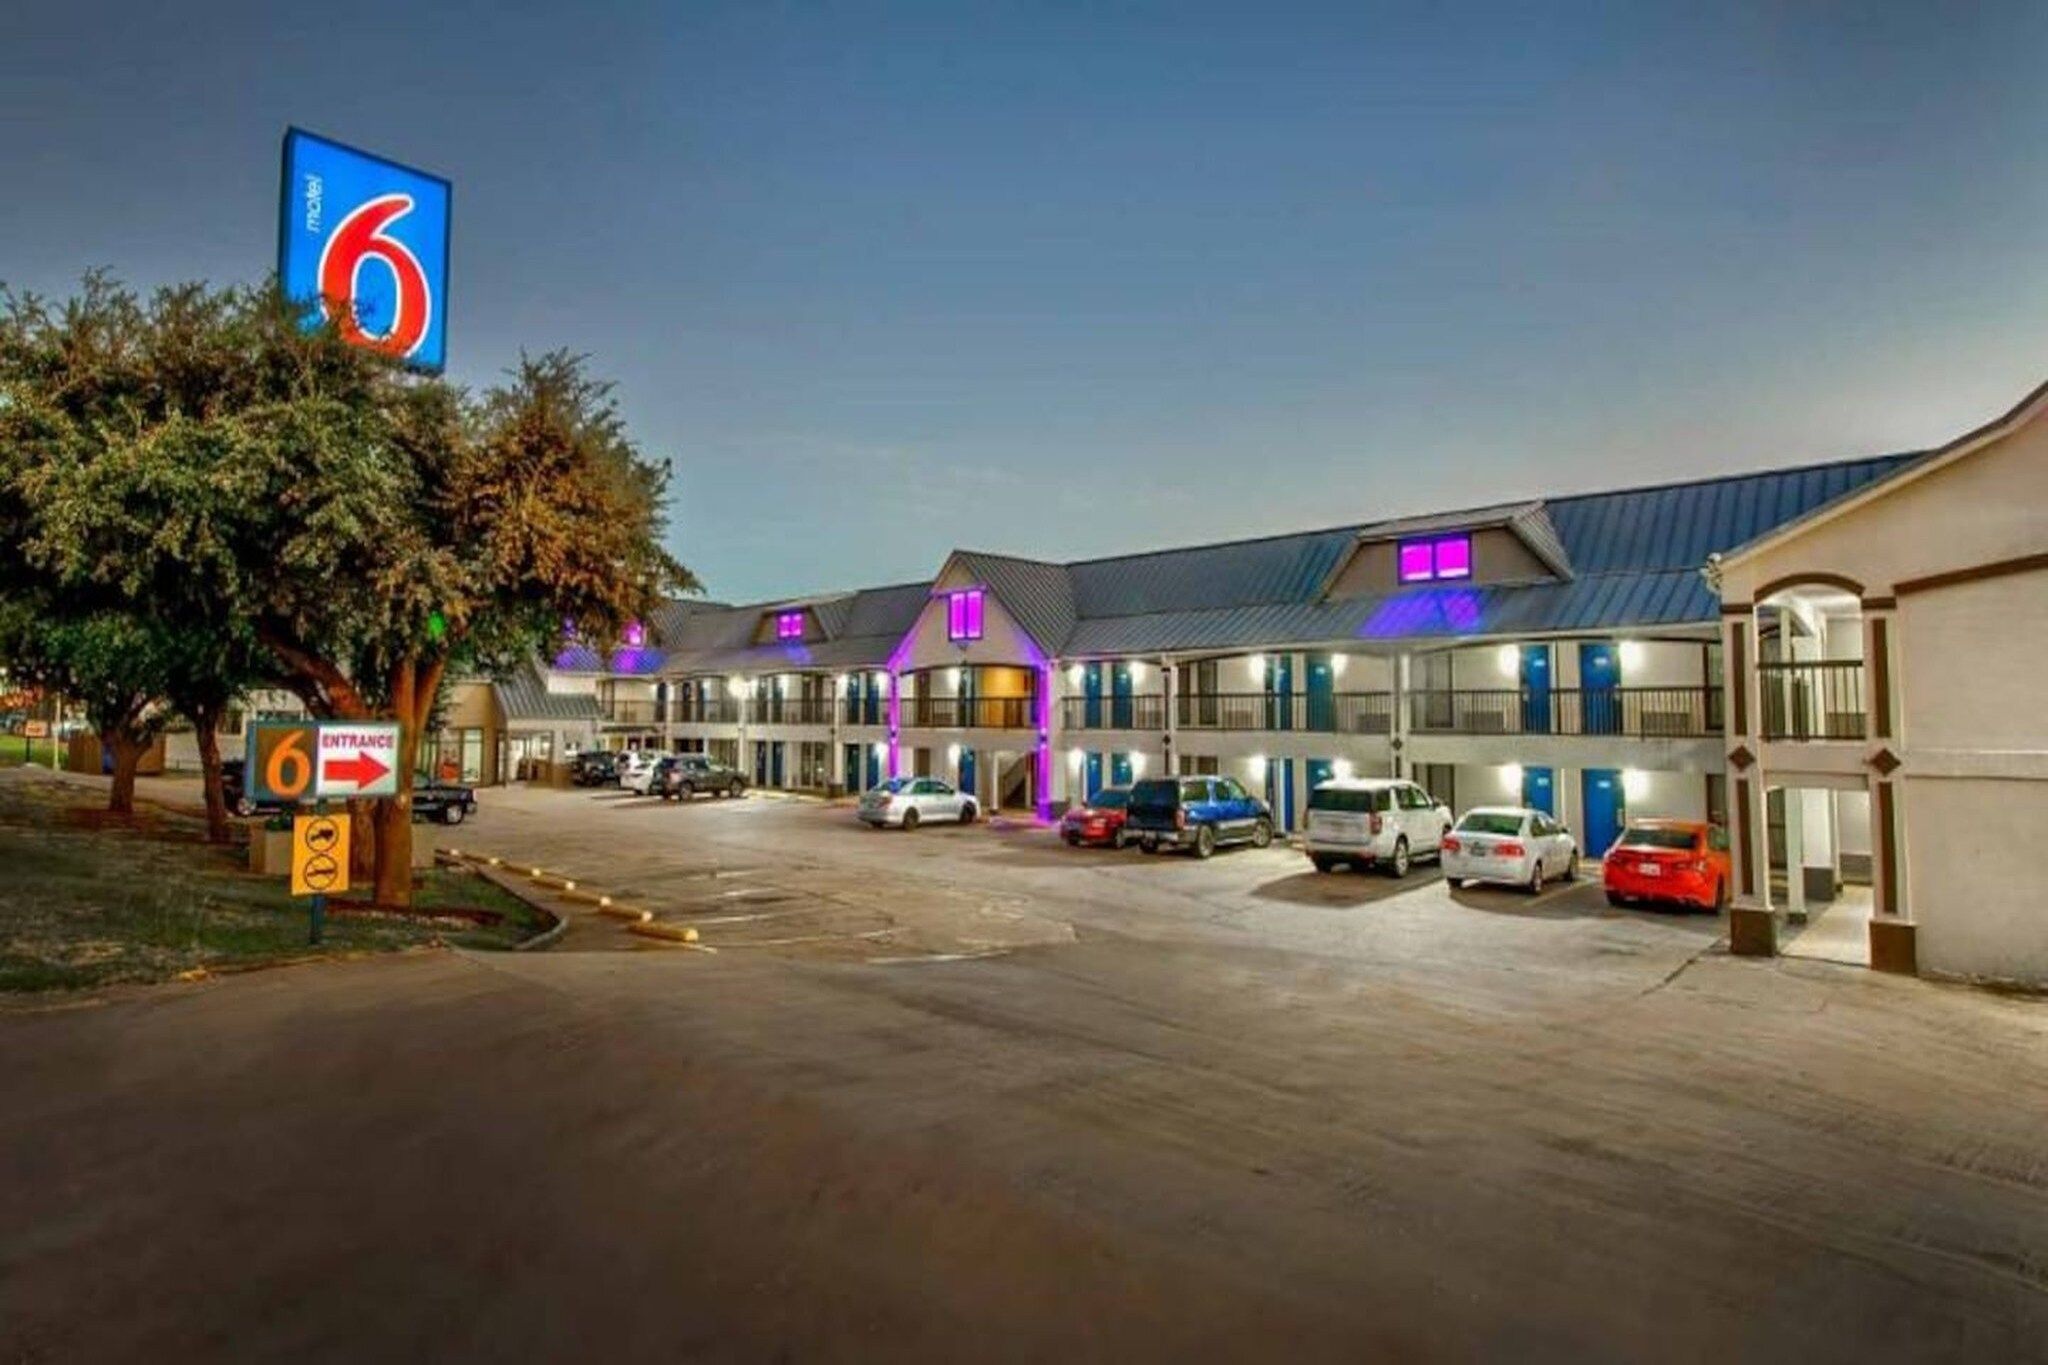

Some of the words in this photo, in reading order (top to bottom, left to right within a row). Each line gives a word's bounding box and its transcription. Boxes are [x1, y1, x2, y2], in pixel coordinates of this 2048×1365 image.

[304, 174, 323, 232] motel
[317, 192, 432, 358] 6
[267, 730, 311, 799] 6
[322, 734, 394, 749] ENTRANCE
